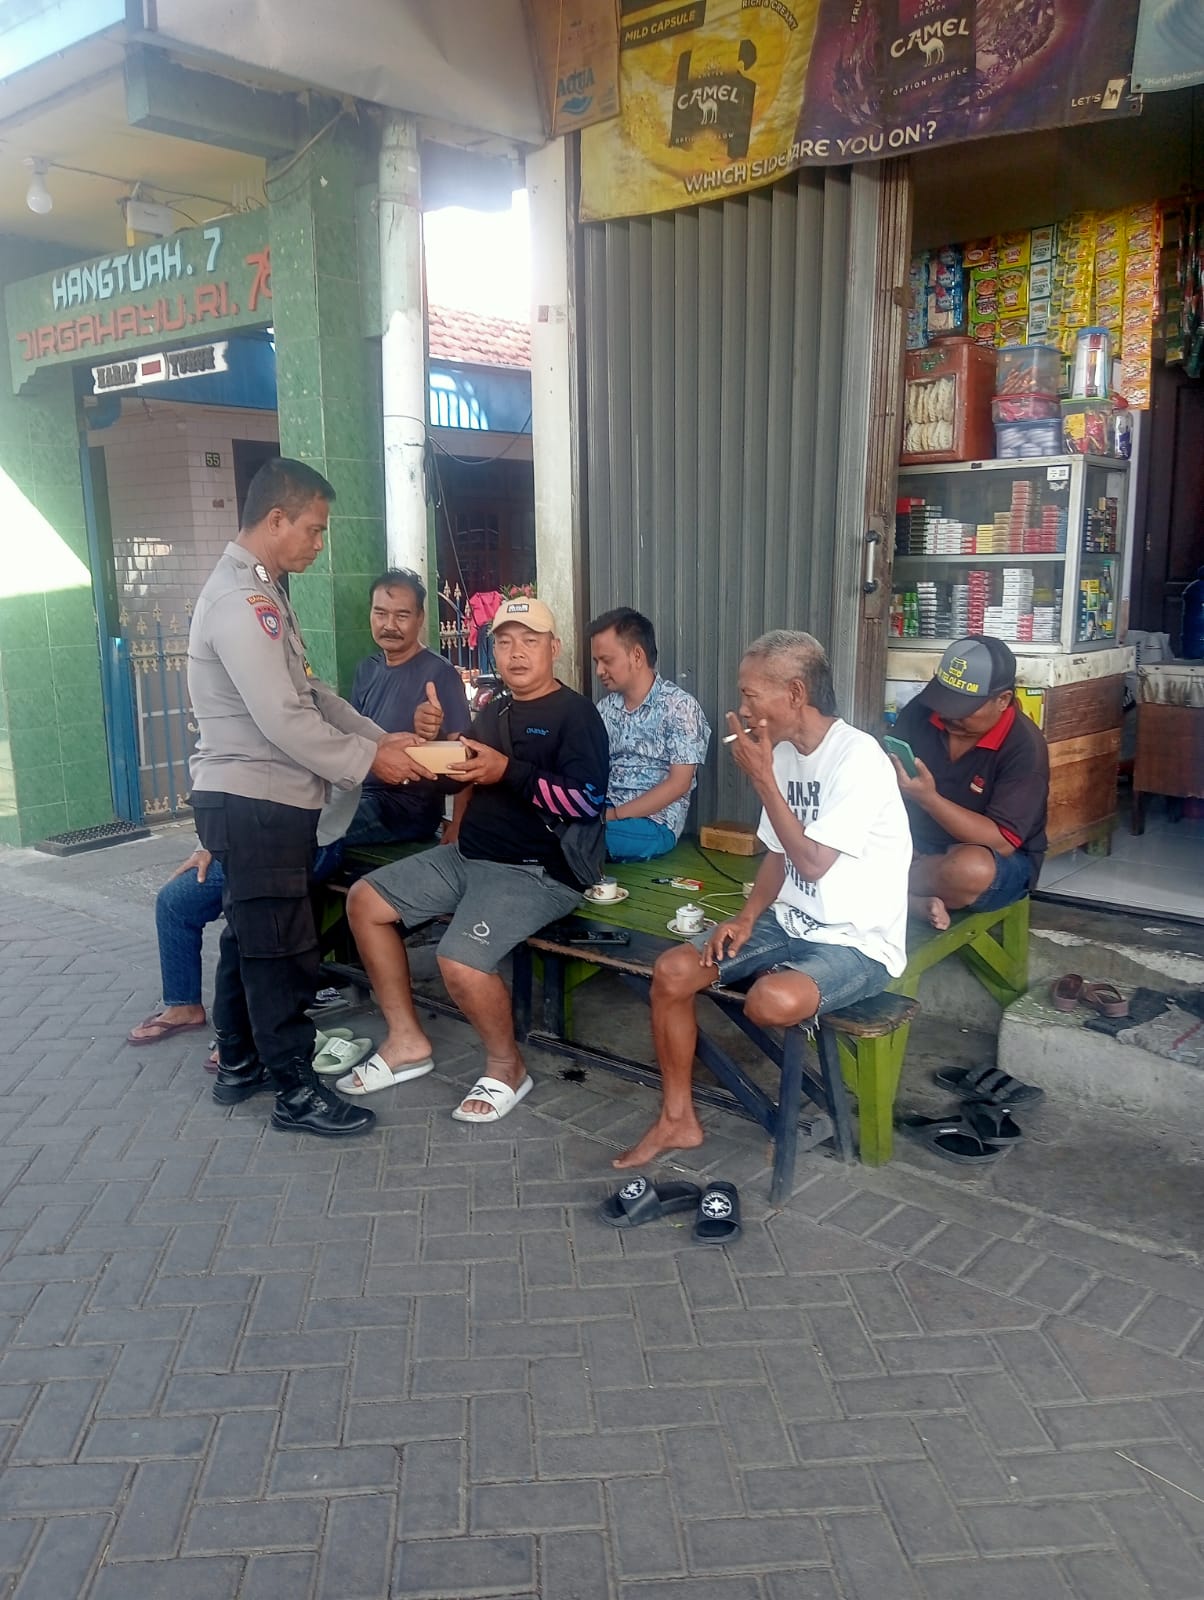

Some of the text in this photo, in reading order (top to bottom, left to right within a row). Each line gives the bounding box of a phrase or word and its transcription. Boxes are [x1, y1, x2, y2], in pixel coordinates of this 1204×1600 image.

[625, 9, 697, 43] MILD CAPSULE
[771, 0, 798, 31] CREAMY
[889, 18, 970, 58] CAMEL
[677, 84, 739, 110] CAMEL
[892, 67, 969, 96] OPTION PURPLE
[1071, 93, 1102, 107] LET'S
[685, 163, 748, 193] WHICH
[751, 153, 787, 178] SIDE
[788, 139, 831, 164] ARE
[836, 133, 884, 156] YOU
[203, 227, 222, 272] 7
[206, 453, 220, 466] 55
